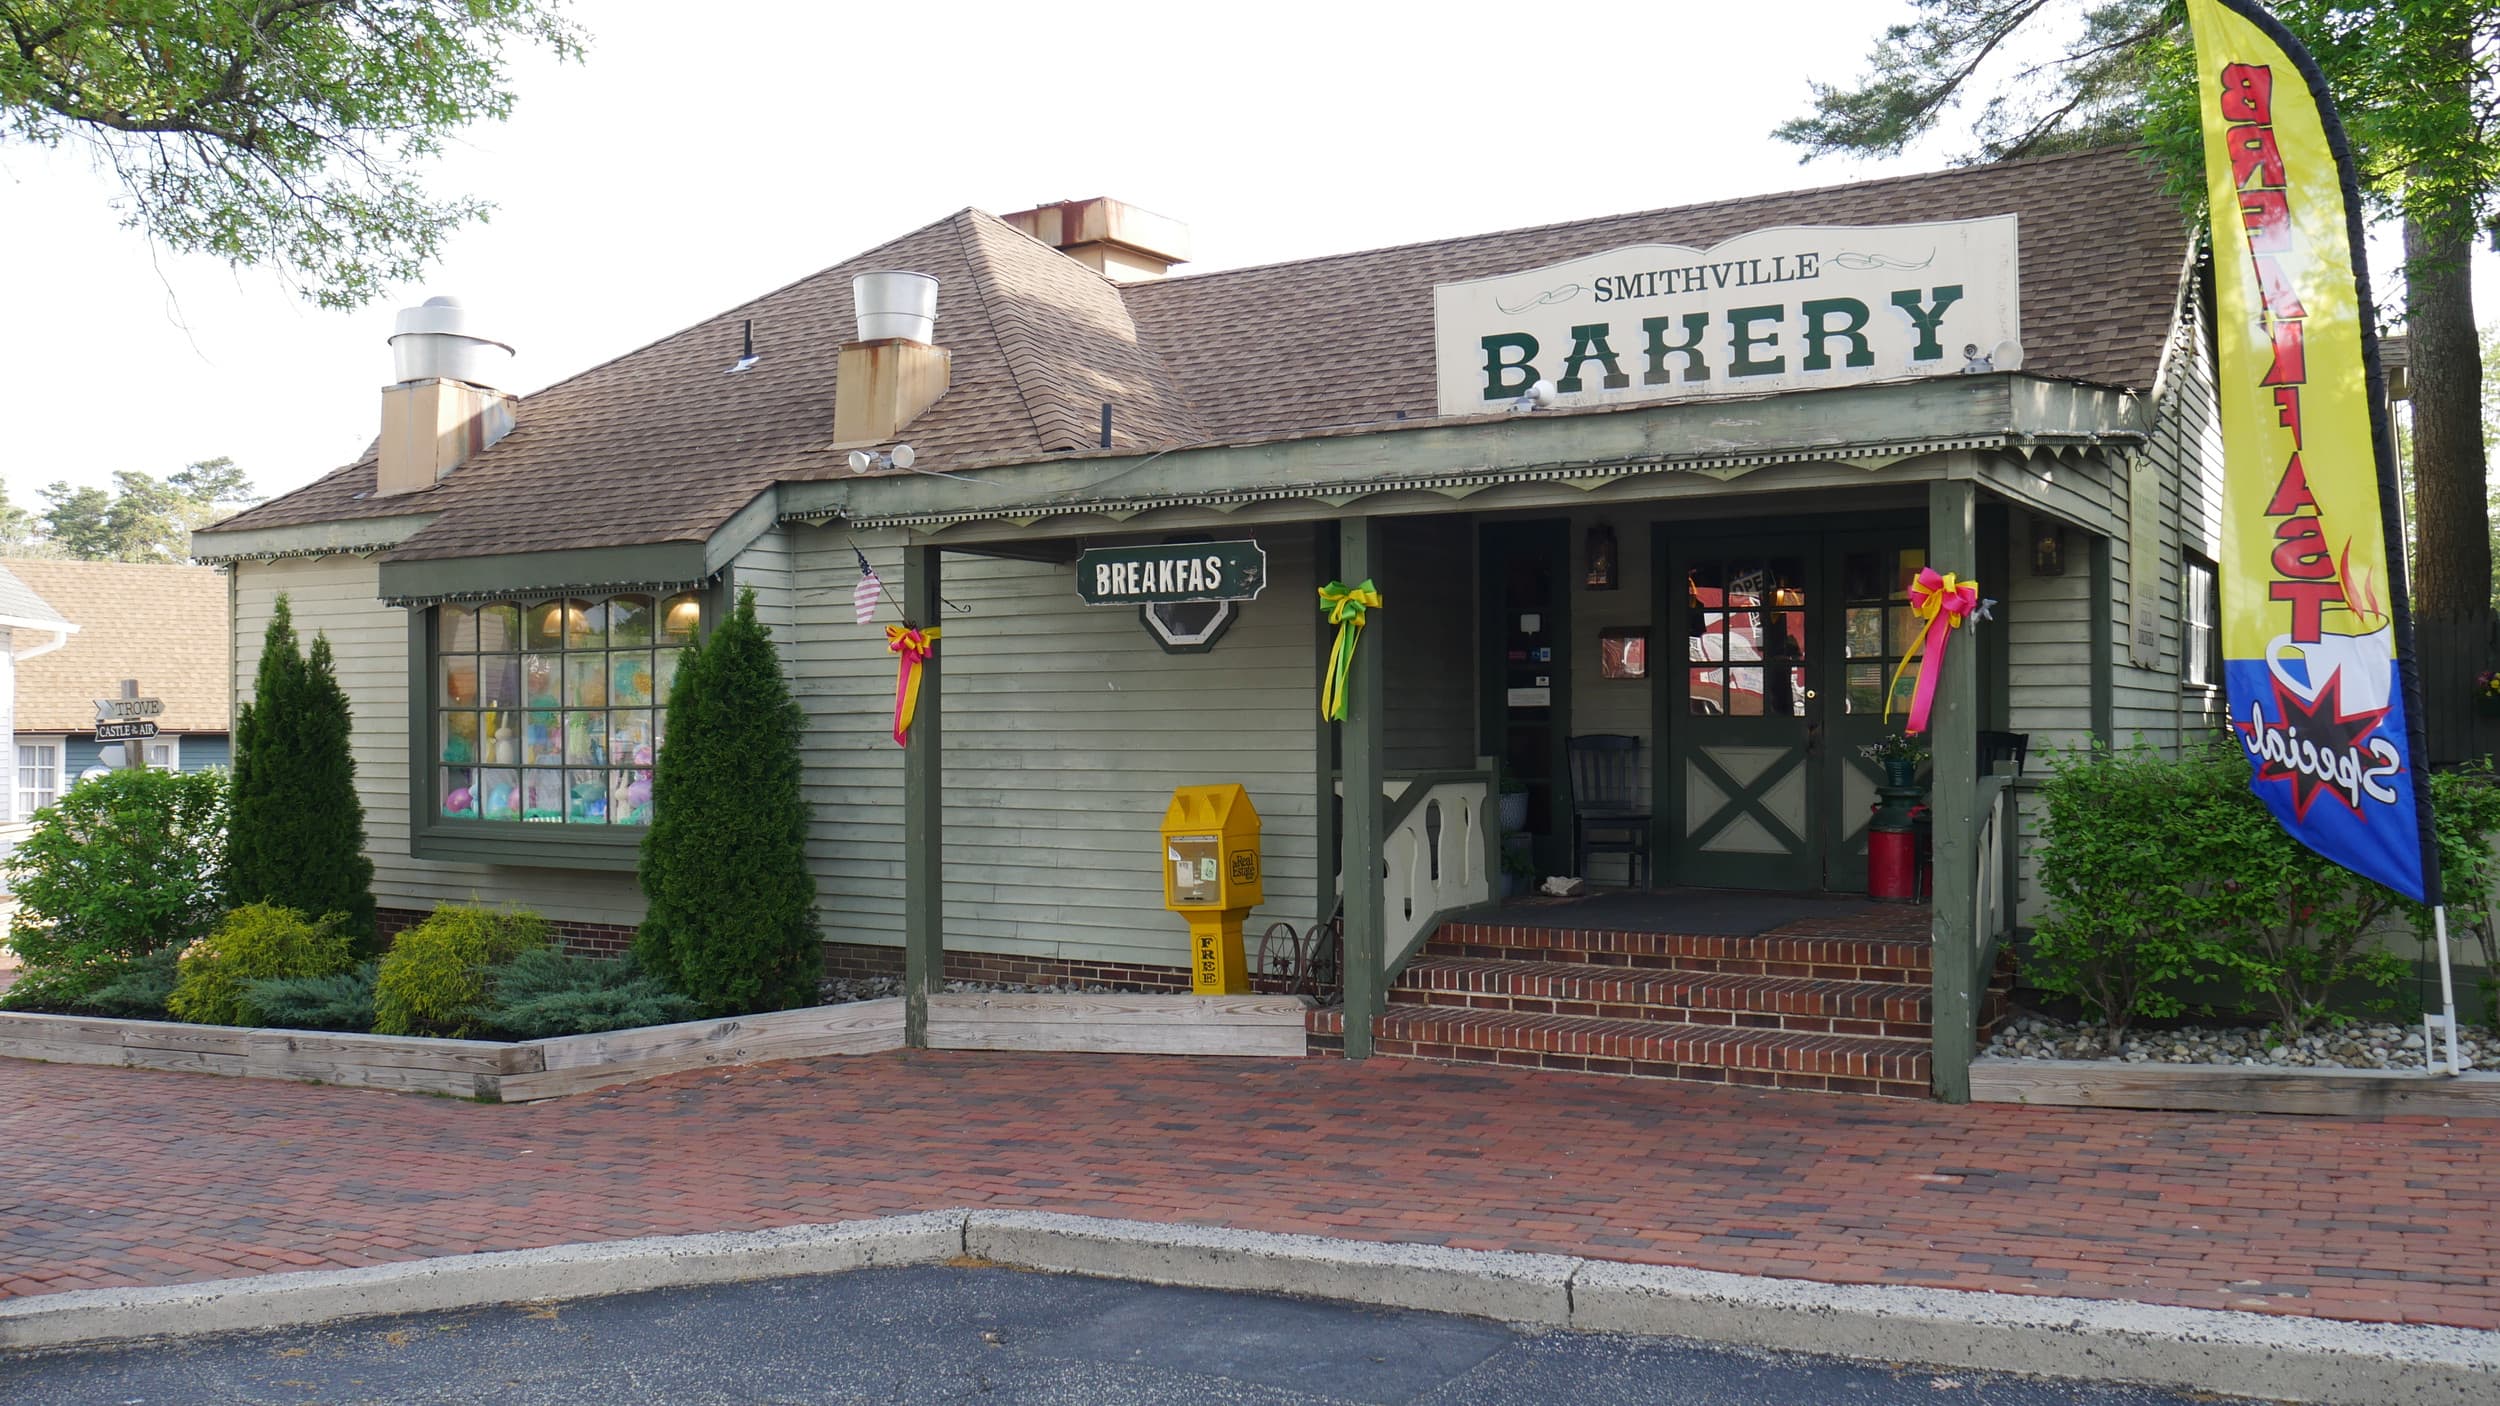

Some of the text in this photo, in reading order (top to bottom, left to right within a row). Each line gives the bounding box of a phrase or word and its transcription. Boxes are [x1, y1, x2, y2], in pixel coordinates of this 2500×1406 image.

[1593, 251, 1821, 304] SMITHVILLE
[1480, 284, 1964, 401] BAKERY
[1095, 555, 1222, 596] BREAKFAS
[115, 700, 160, 716] TROVE
[99, 725, 131, 738] CASTLE
[139, 723, 154, 736] AIR
[1200, 937, 1217, 985] FREE
